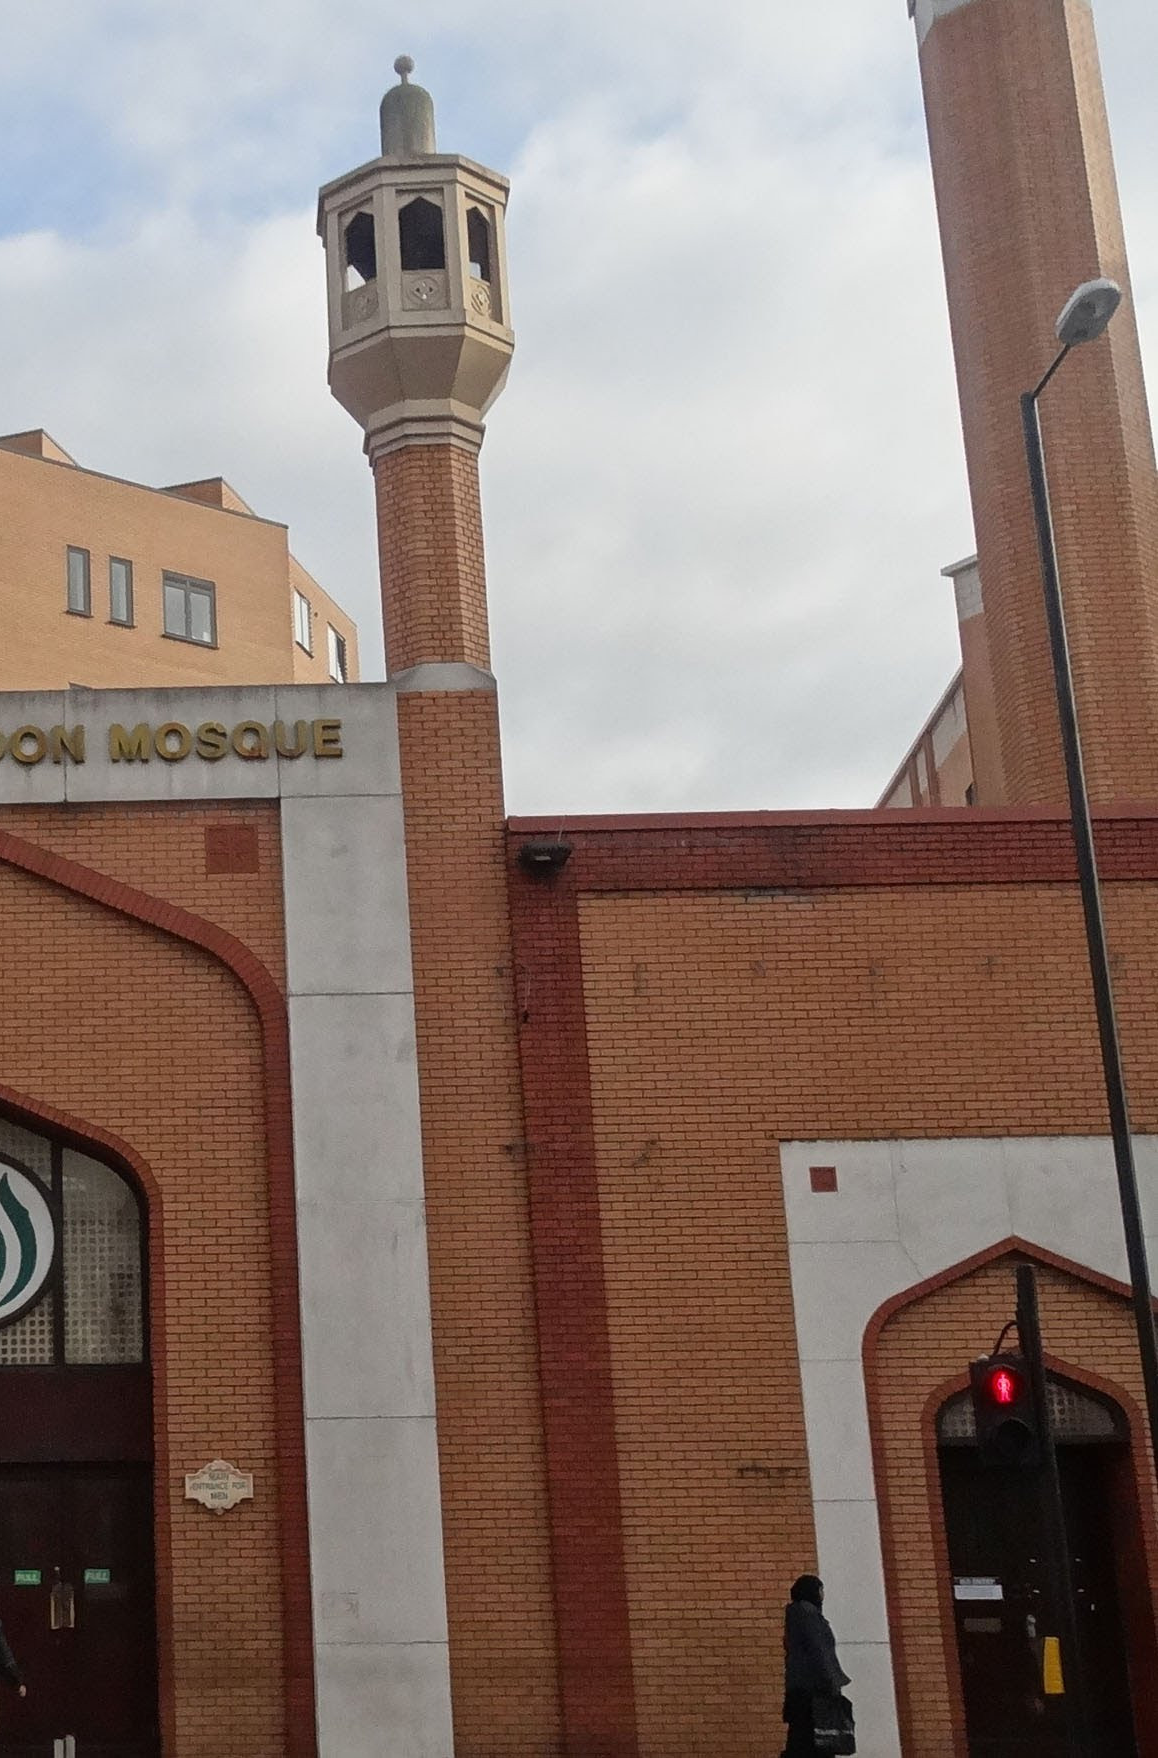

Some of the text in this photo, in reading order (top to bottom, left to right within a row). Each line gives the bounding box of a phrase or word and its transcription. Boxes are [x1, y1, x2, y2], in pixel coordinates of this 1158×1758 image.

[108, 718, 345, 764] MOSQUE
[191, 1481, 246, 1491] ENTRANCE FOR
[210, 1491, 228, 1500] MEN
